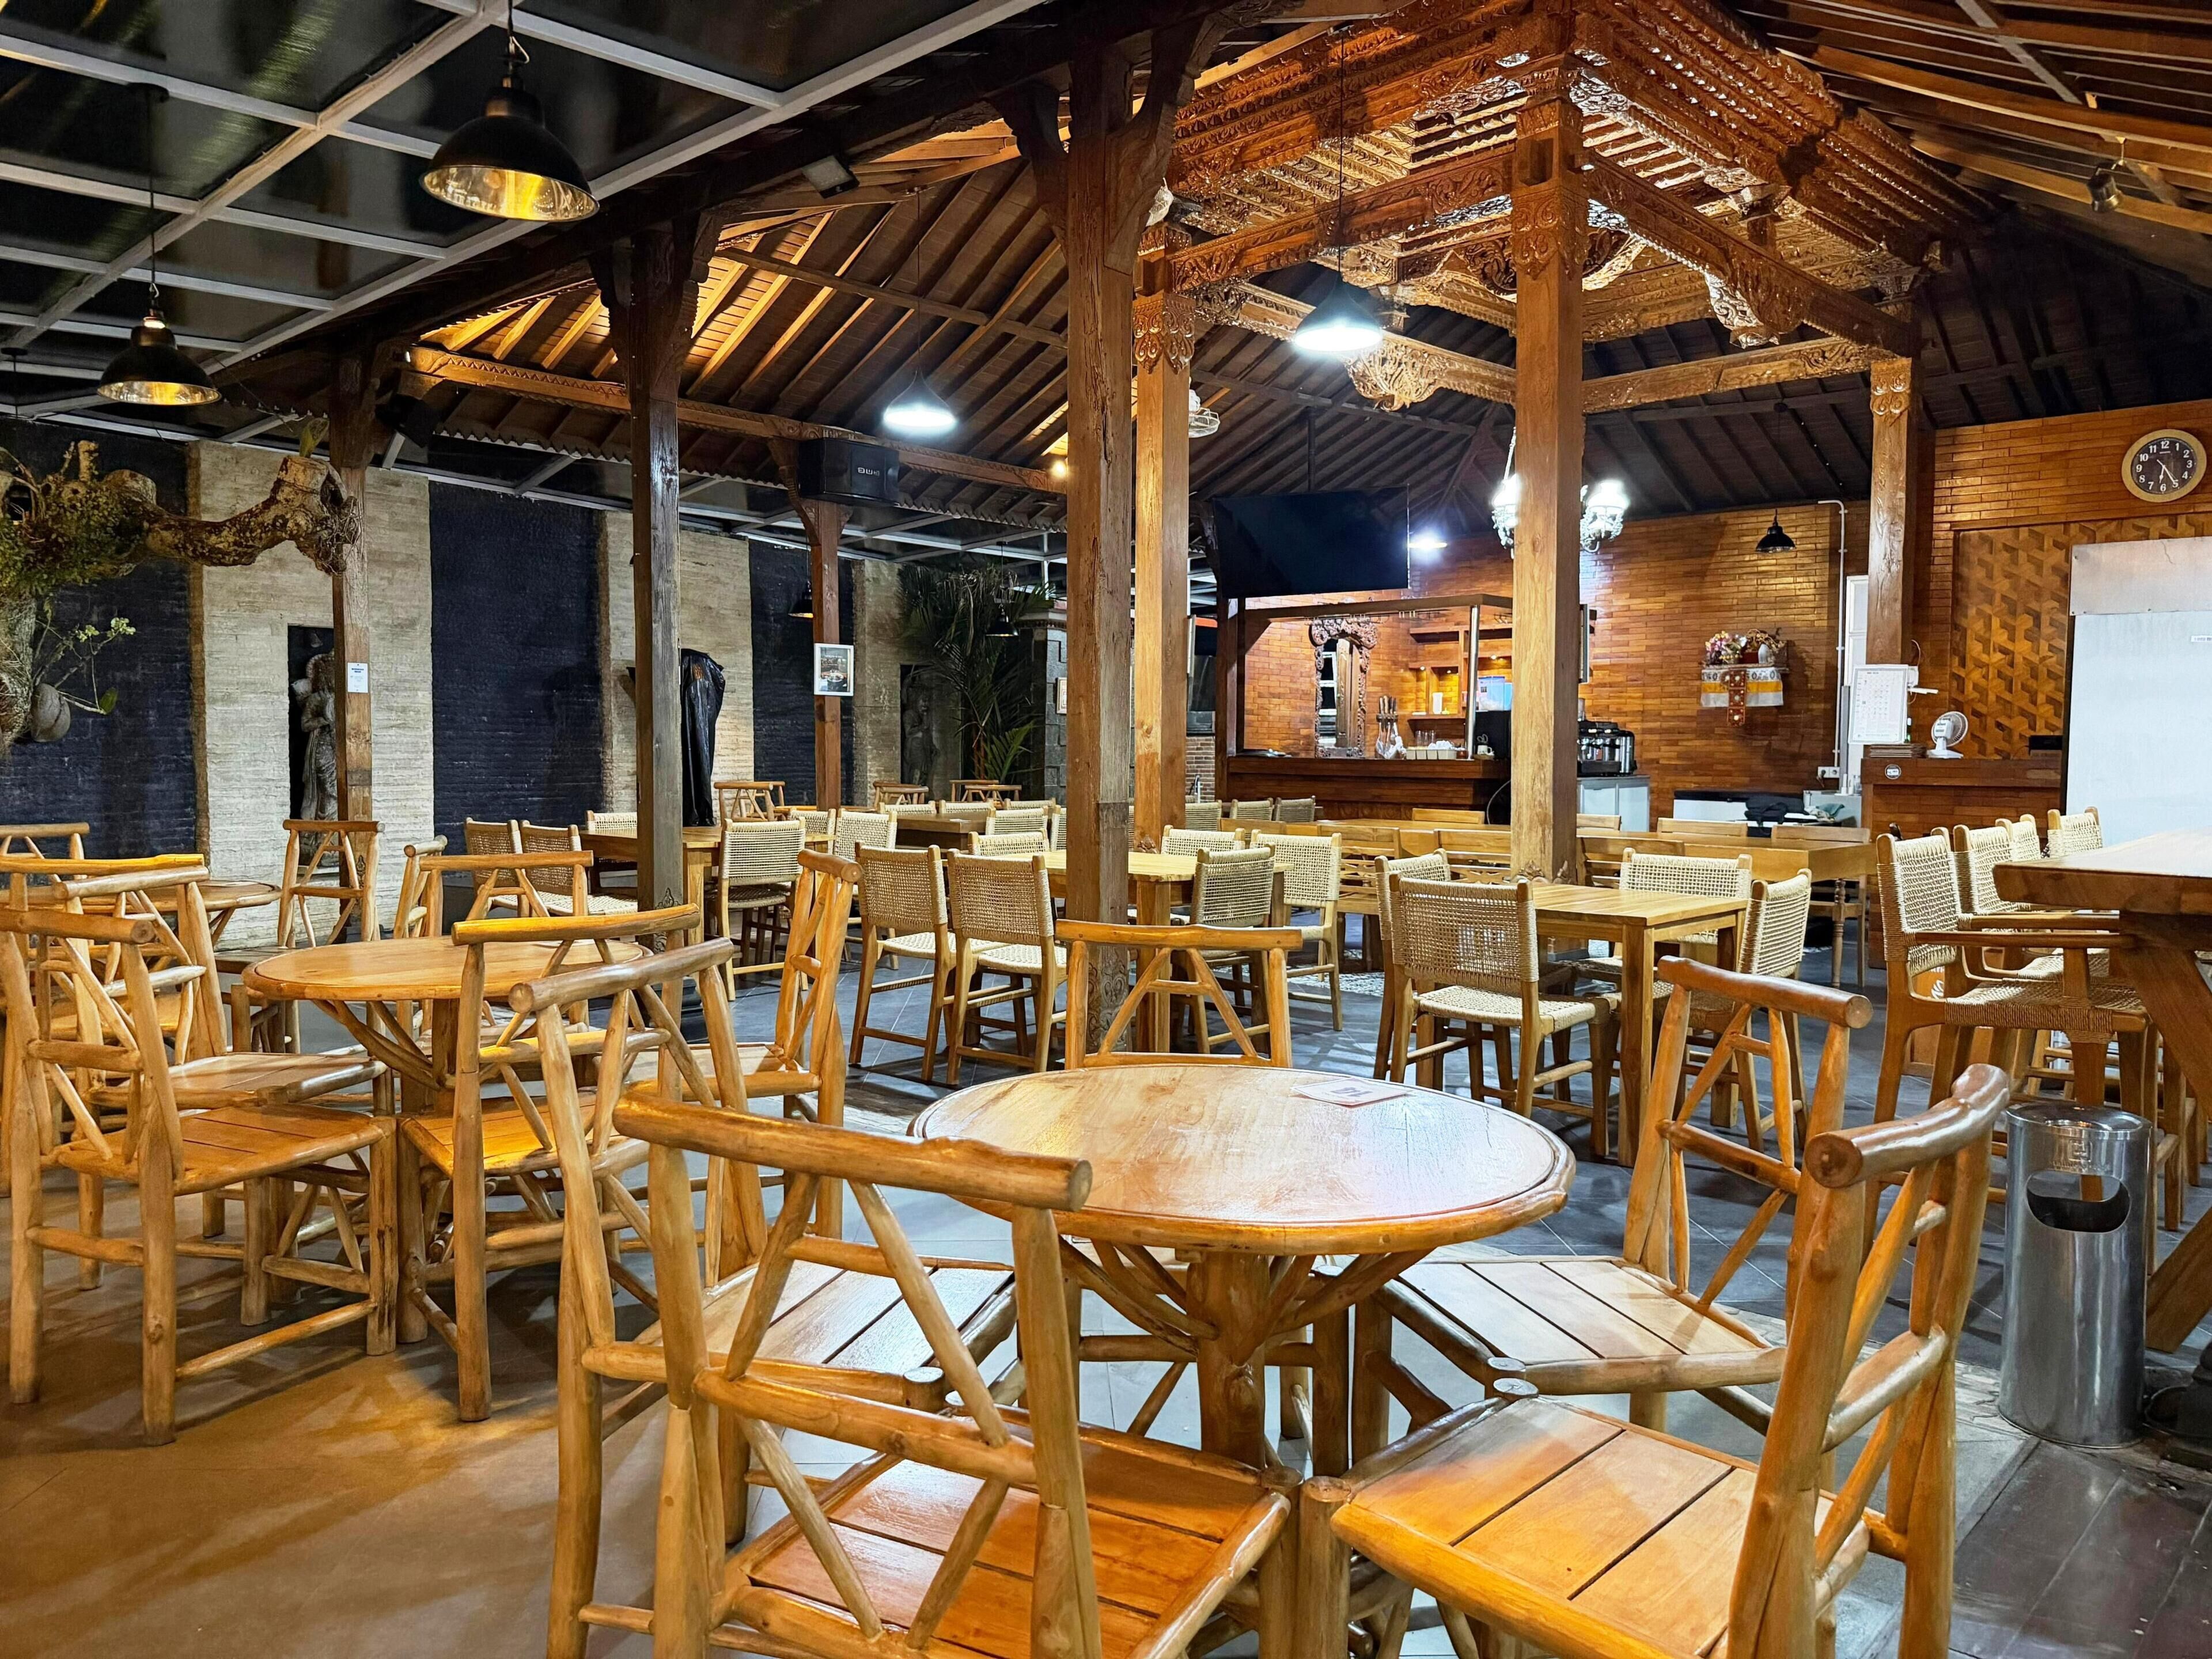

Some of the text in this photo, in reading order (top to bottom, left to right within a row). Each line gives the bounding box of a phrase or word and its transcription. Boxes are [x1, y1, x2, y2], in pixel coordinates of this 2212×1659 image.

[2161, 441, 2169, 449] 12
[2139, 453, 2149, 461] 10
[2183, 450, 2190, 458] 2
[2139, 475, 2145, 483] 8
[2182, 471, 2188, 479] 4
[2148, 482, 2154, 490] 7
[2172, 479, 2179, 488] 5
